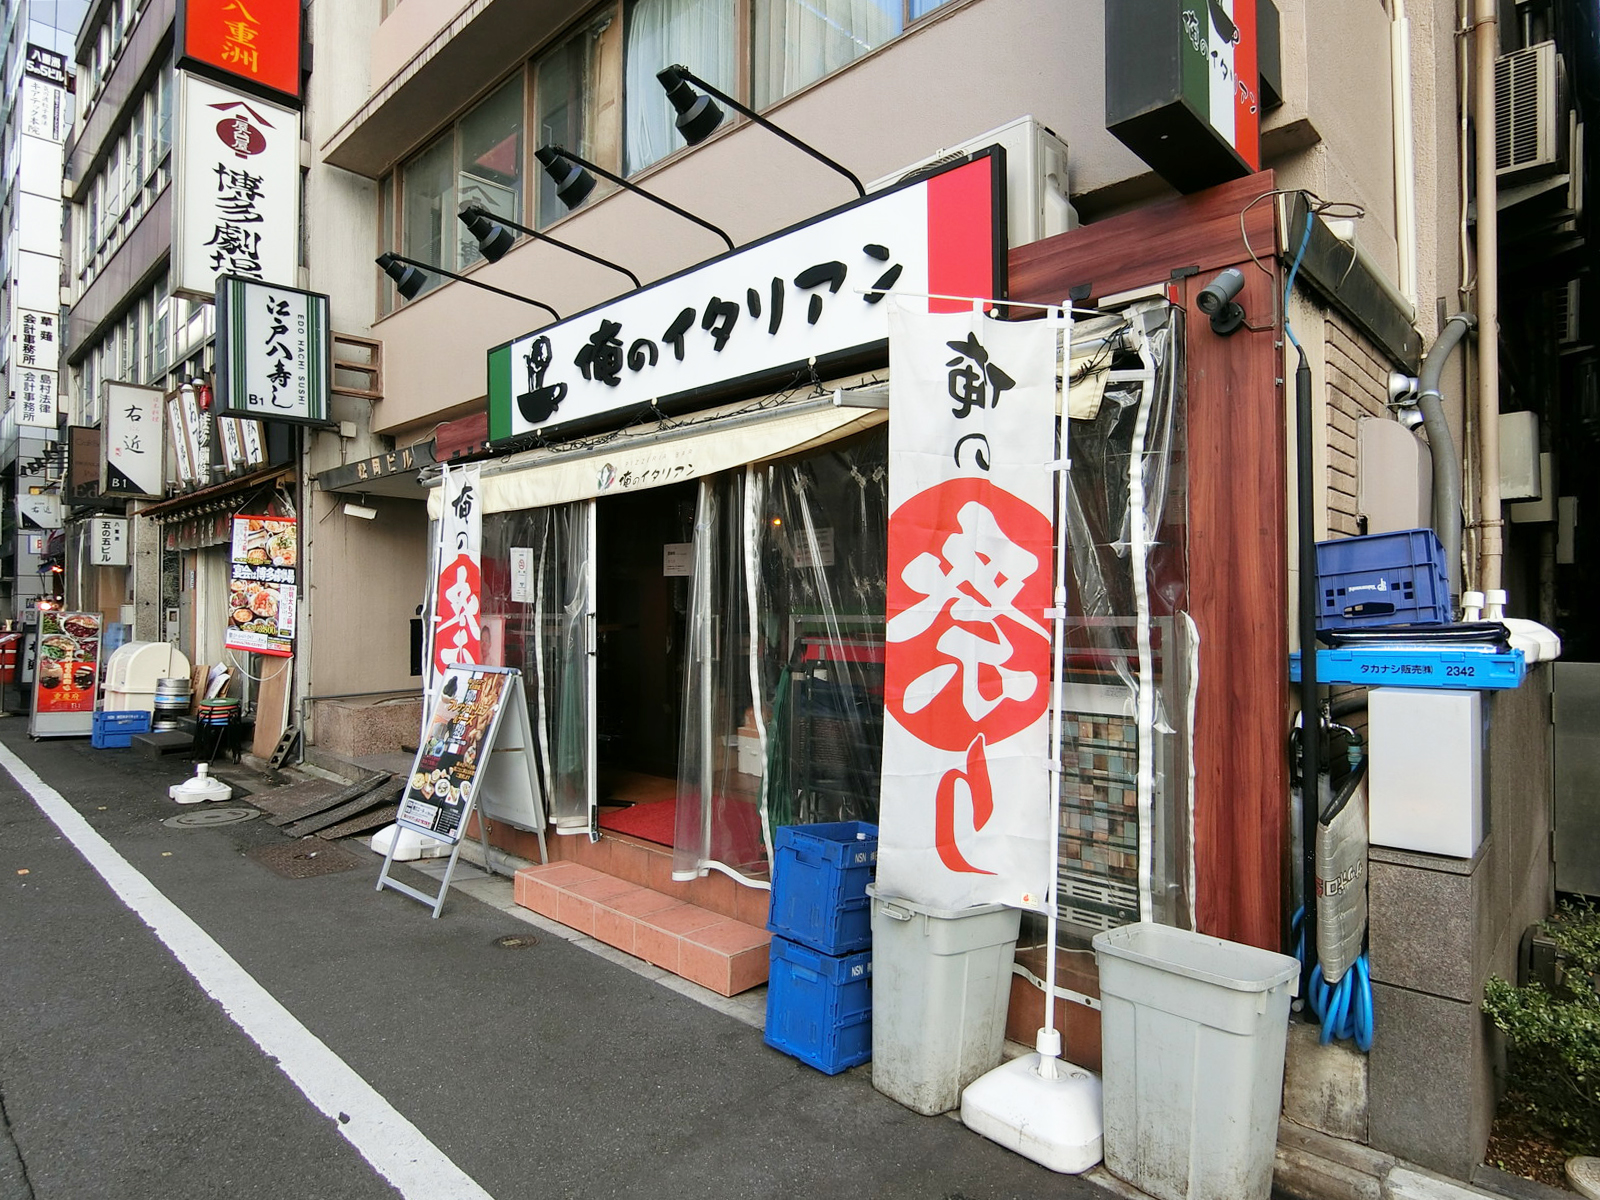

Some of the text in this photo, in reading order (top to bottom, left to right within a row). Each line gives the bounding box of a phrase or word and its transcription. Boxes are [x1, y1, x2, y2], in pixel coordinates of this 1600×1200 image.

[221, 0, 259, 73] 八重洲
[204, 161, 266, 279] 博多劇場
[297, 314, 305, 335] EDO
[574, 243, 903, 387] 俺のイタリアン
[22, 313, 36, 365] 会計事務所
[265, 294, 293, 409] 江戸八寿し
[297, 340, 305, 370] HACHI
[22, 371, 36, 422] 会計事務所
[248, 393, 264, 406] B1
[123, 404, 145, 454] 右近
[111, 477, 127, 489] B1
[618, 463, 695, 488] 俺のイタリアン
[73, 483, 108, 499] Ed
[101, 521, 112, 562] 五の五ビル
[1445, 665, 1475, 677] 2342
[854, 851, 867, 863] NSN
[851, 964, 864, 978] NSN
